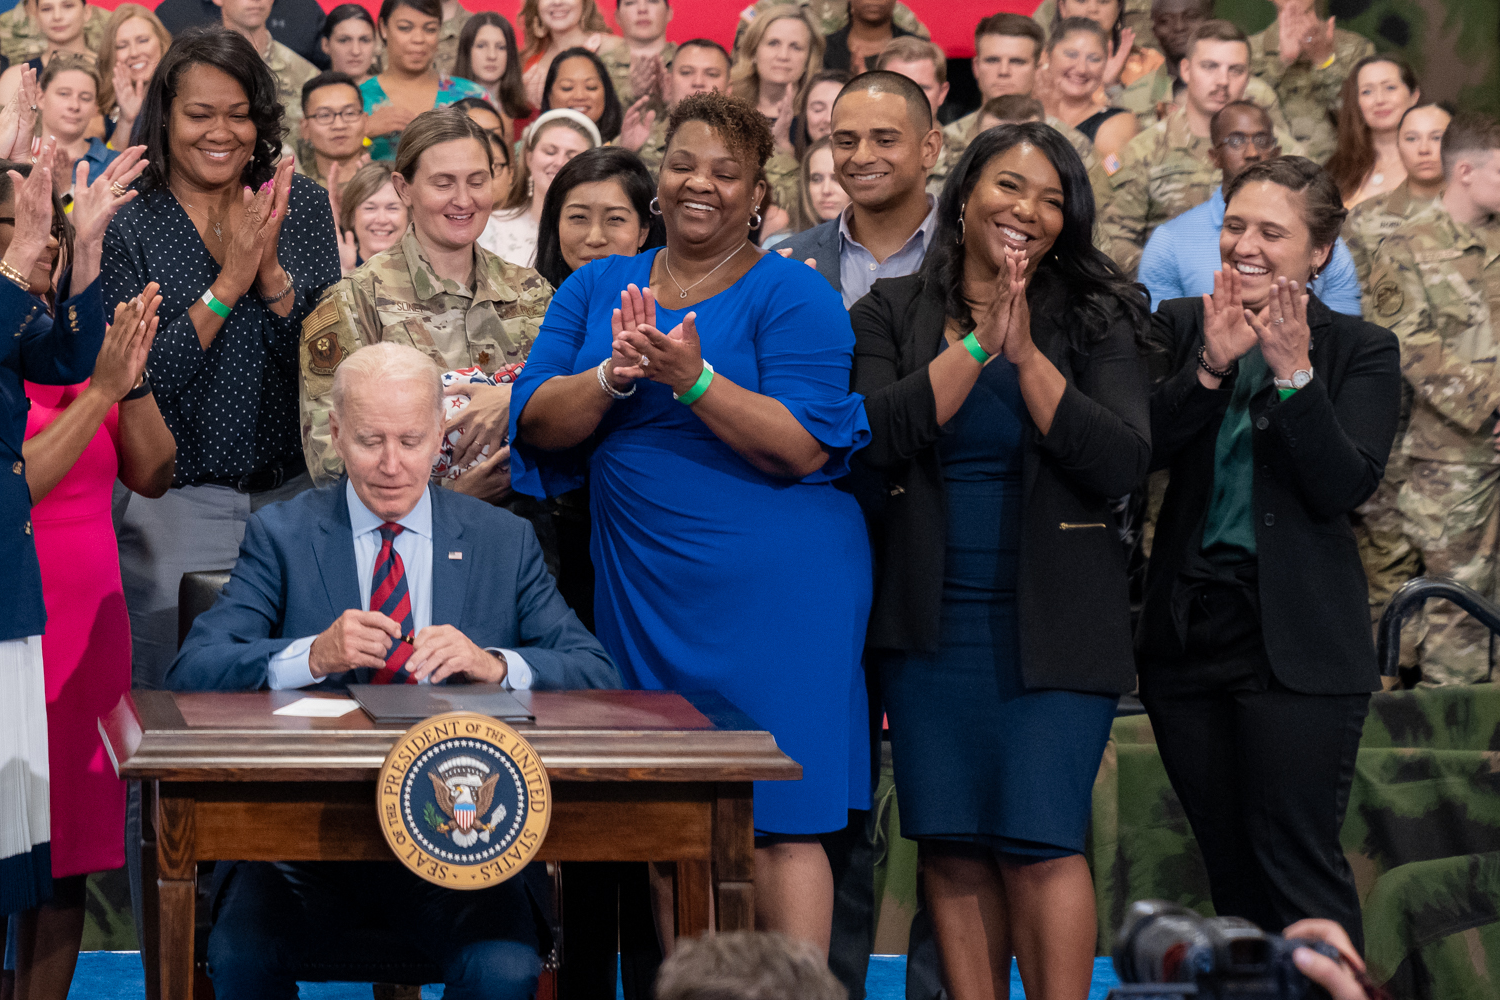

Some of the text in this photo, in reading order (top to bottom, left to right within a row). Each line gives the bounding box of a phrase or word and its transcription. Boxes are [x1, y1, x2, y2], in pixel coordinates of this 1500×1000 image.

[384, 721, 546, 880] SEAL OF THE PRESIDENT OF THE UNITED STATES
